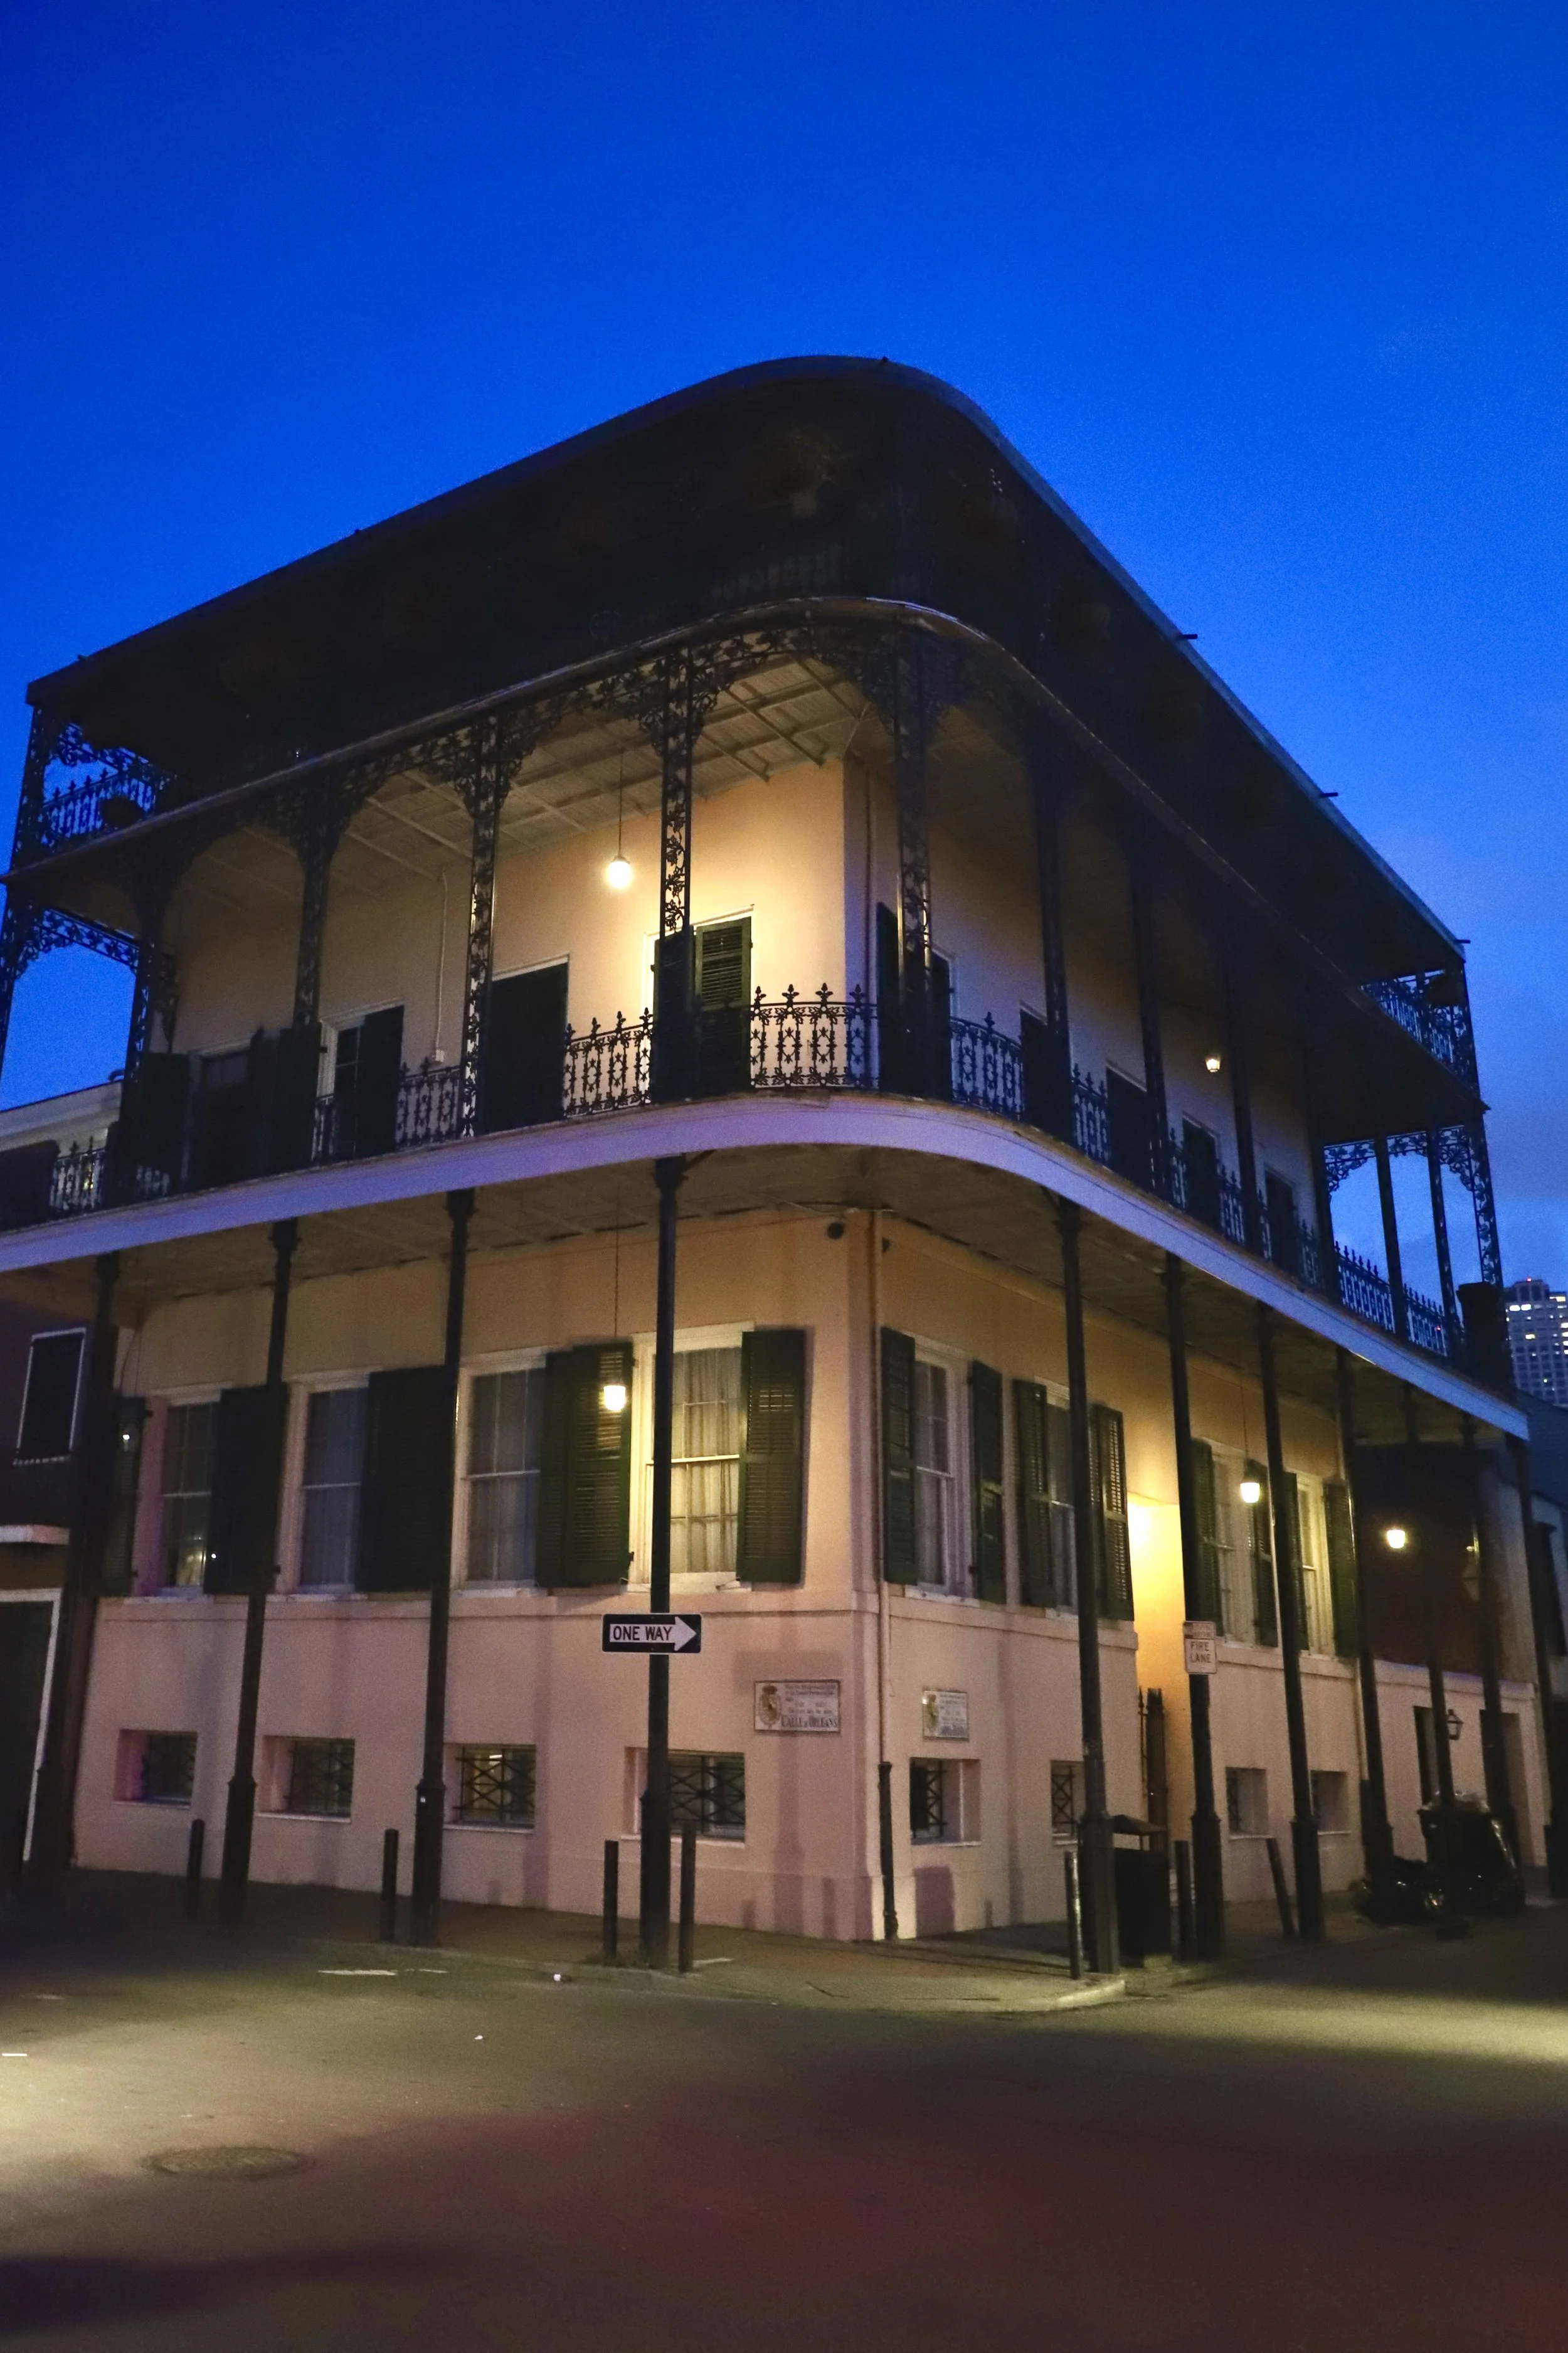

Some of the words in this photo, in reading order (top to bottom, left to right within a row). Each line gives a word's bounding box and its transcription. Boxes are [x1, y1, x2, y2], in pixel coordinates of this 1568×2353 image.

[613, 1626, 640, 1641] ONE
[645, 1626, 672, 1641] WAY
[1191, 1641, 1209, 1652] FIRE
[1191, 1653, 1211, 1664] LANE
